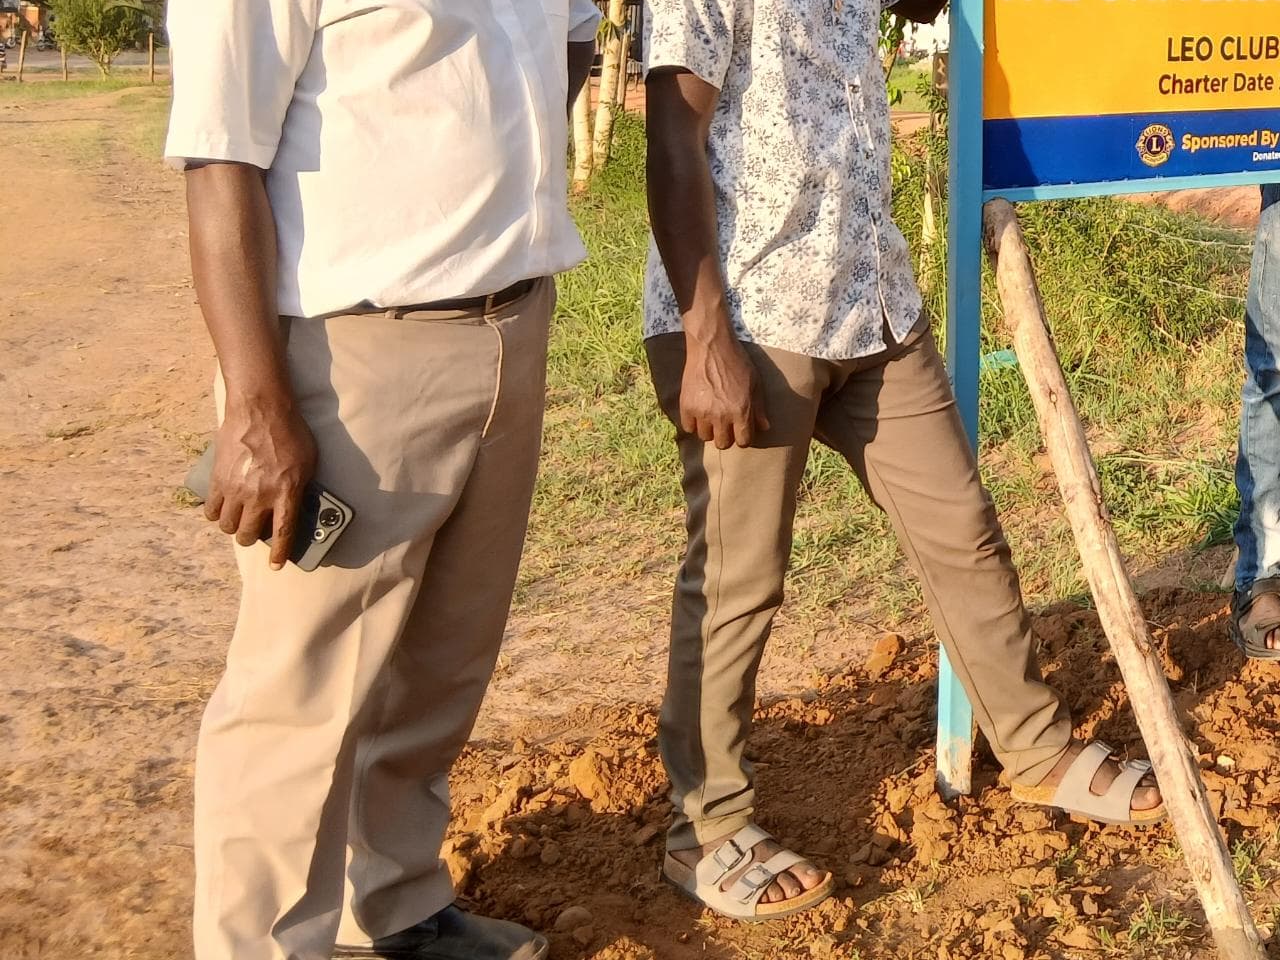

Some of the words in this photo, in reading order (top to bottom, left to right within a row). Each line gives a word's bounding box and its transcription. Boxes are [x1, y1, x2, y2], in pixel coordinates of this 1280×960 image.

[1167, 36, 1214, 62] LEO
[1220, 36, 1280, 61] CLUB
[1158, 73, 1229, 95] Charter
[1233, 72, 1274, 92] Date
[1151, 137, 1161, 152] L
[1181, 130, 1257, 153] Sponsored
[1261, 130, 1279, 148] By
